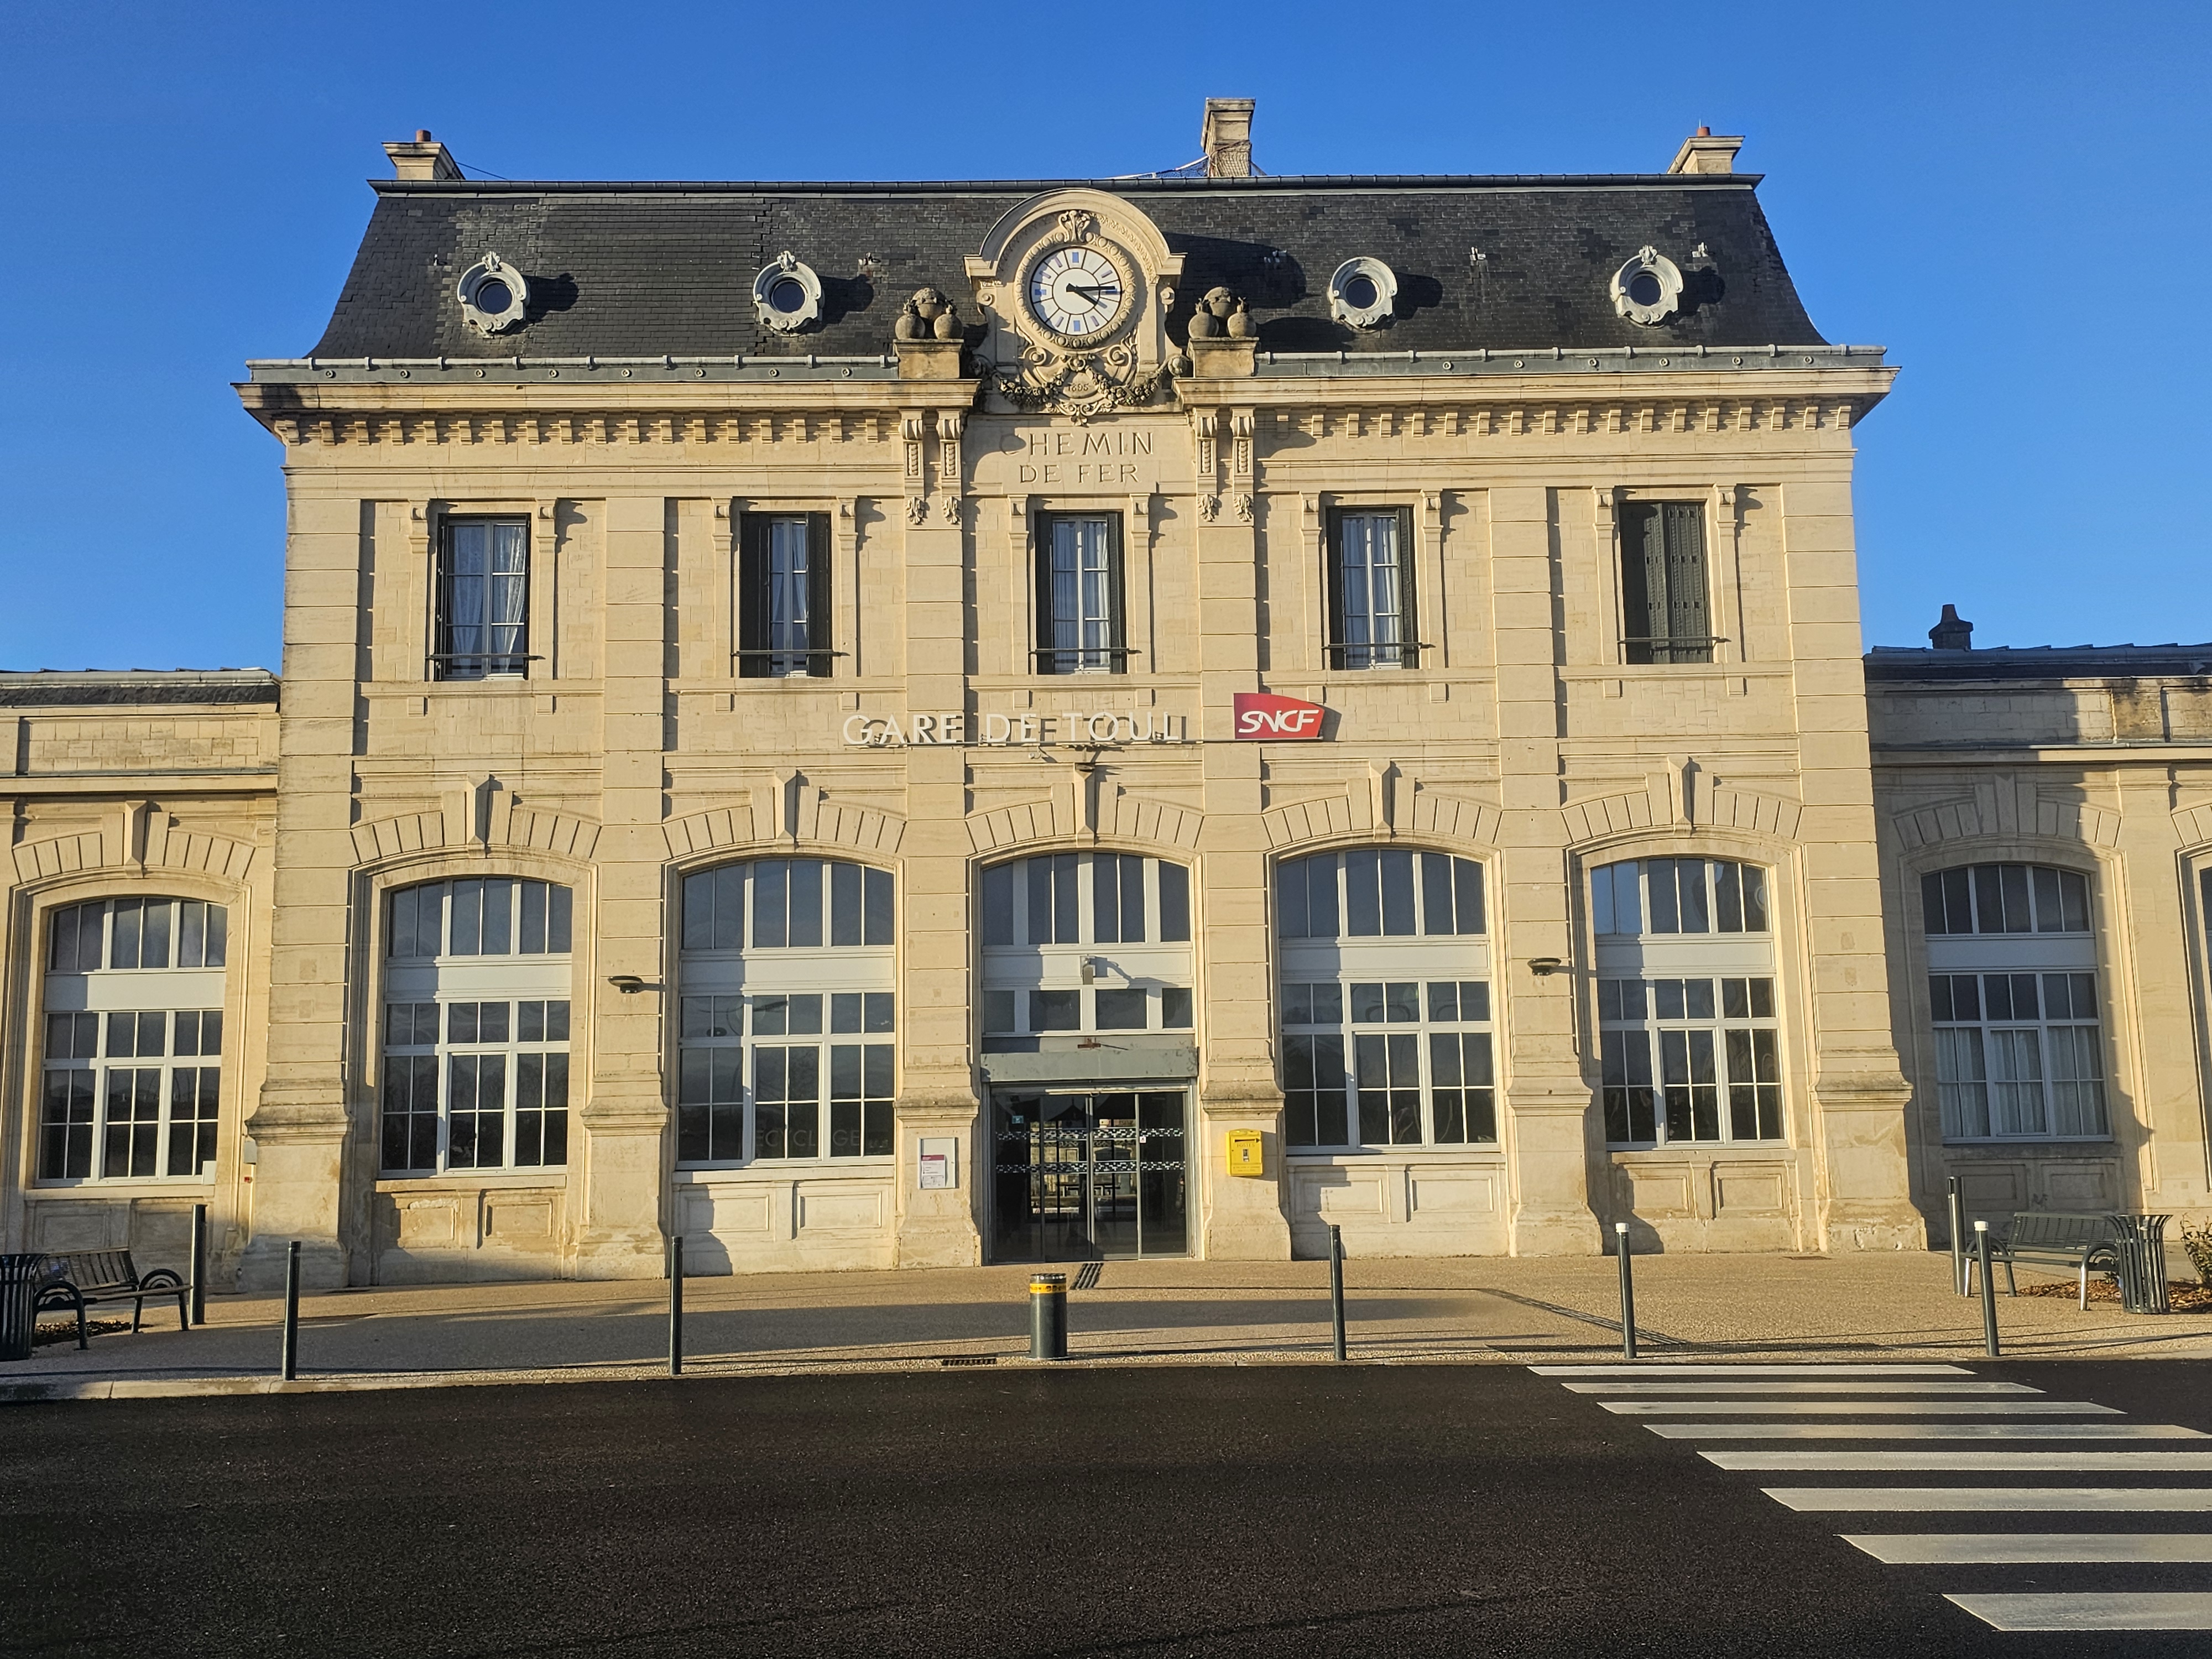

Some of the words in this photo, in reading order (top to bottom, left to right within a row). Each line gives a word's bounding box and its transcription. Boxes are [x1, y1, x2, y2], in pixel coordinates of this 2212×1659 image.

[999, 432, 1154, 456] CHEMIN
[1019, 464, 1062, 484] DE
[1078, 463, 1142, 483] FER
[843, 714, 958, 744] GARE
[987, 713, 1037, 743] DE
[1062, 711, 1179, 742] TOUL
[1238, 709, 1319, 733] SNCF
